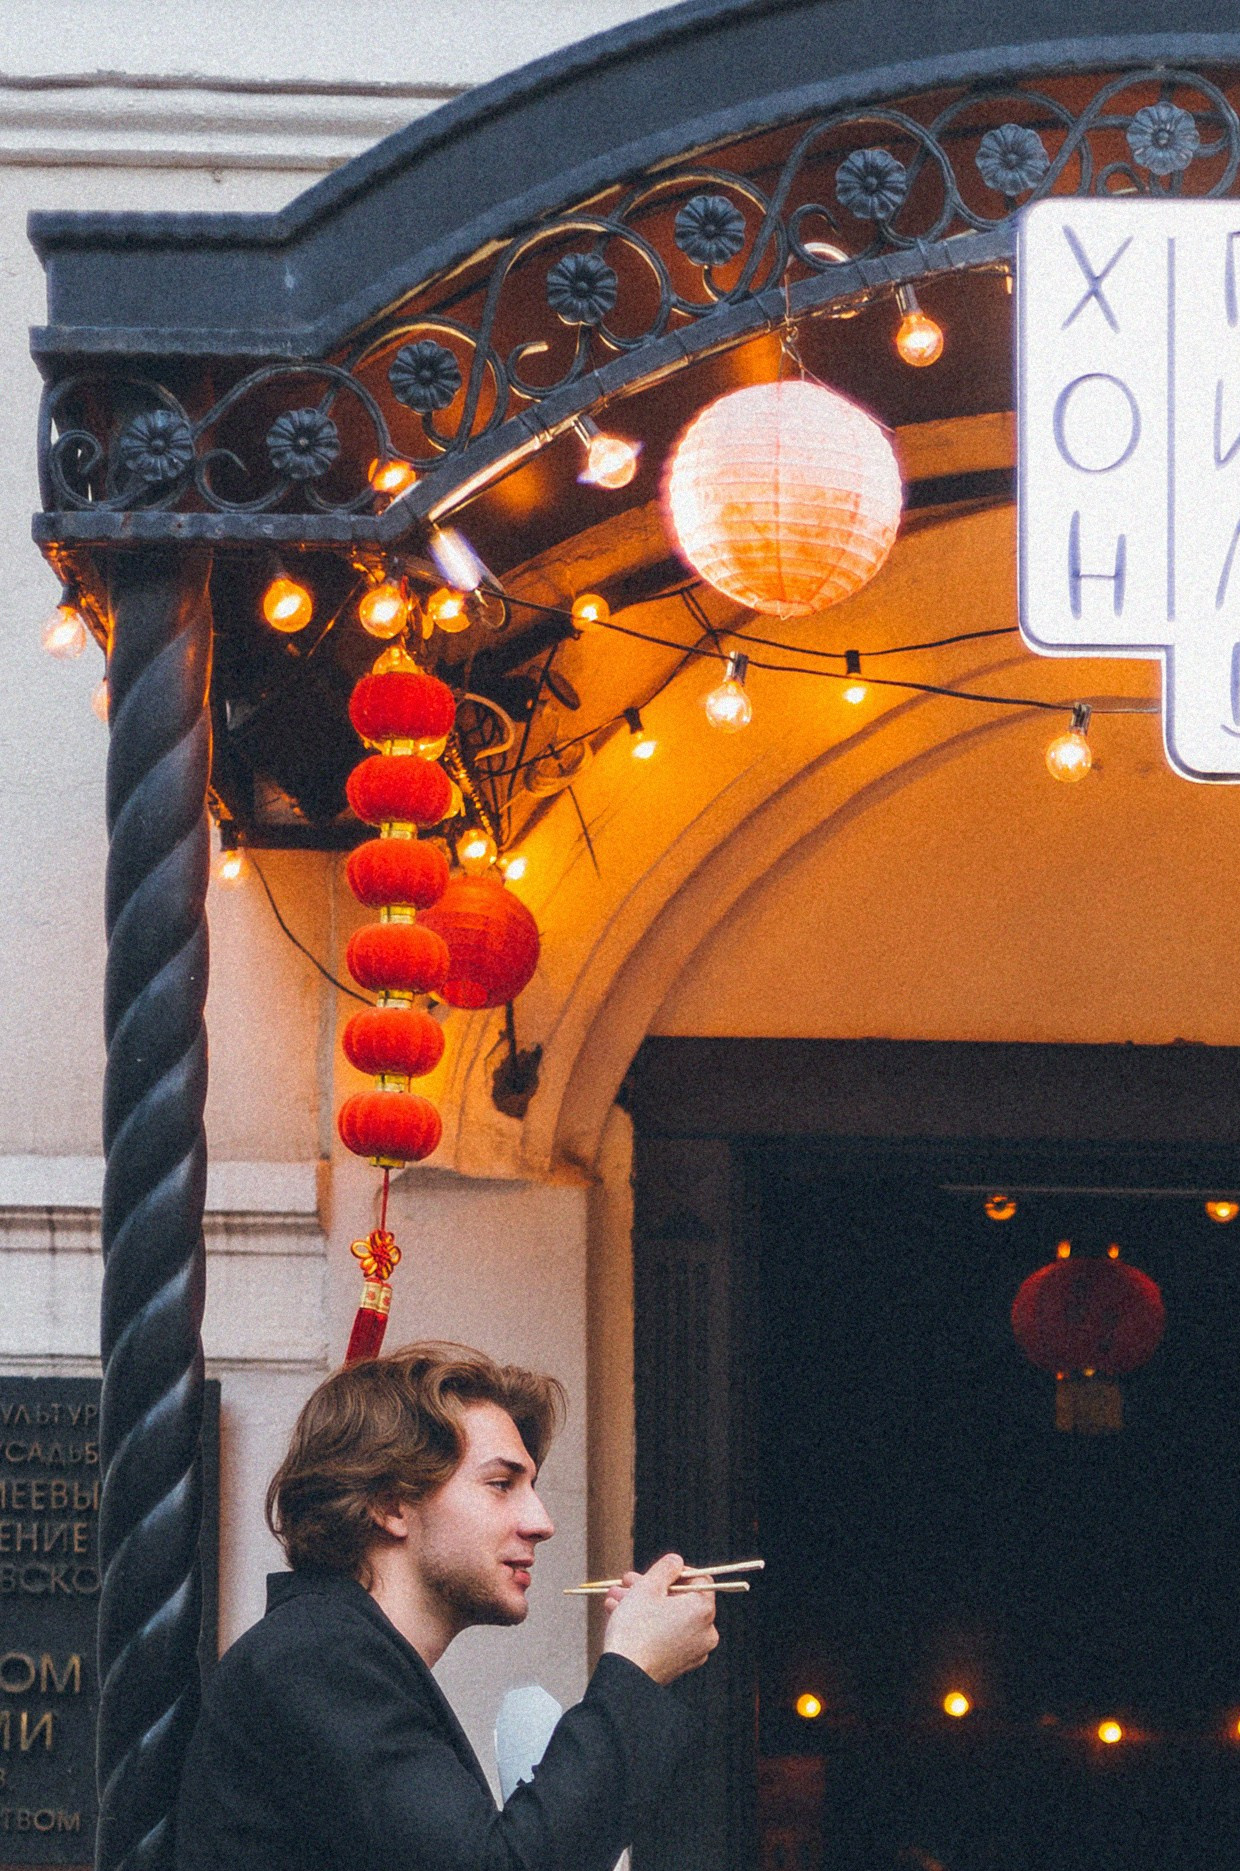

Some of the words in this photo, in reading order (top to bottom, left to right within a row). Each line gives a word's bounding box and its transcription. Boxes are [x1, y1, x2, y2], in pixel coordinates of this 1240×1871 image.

[1051, 224, 1142, 621] ХОН
[0, 1438, 99, 1464] САДЬБ
[0, 1479, 99, 1509] ЕЕВЫ
